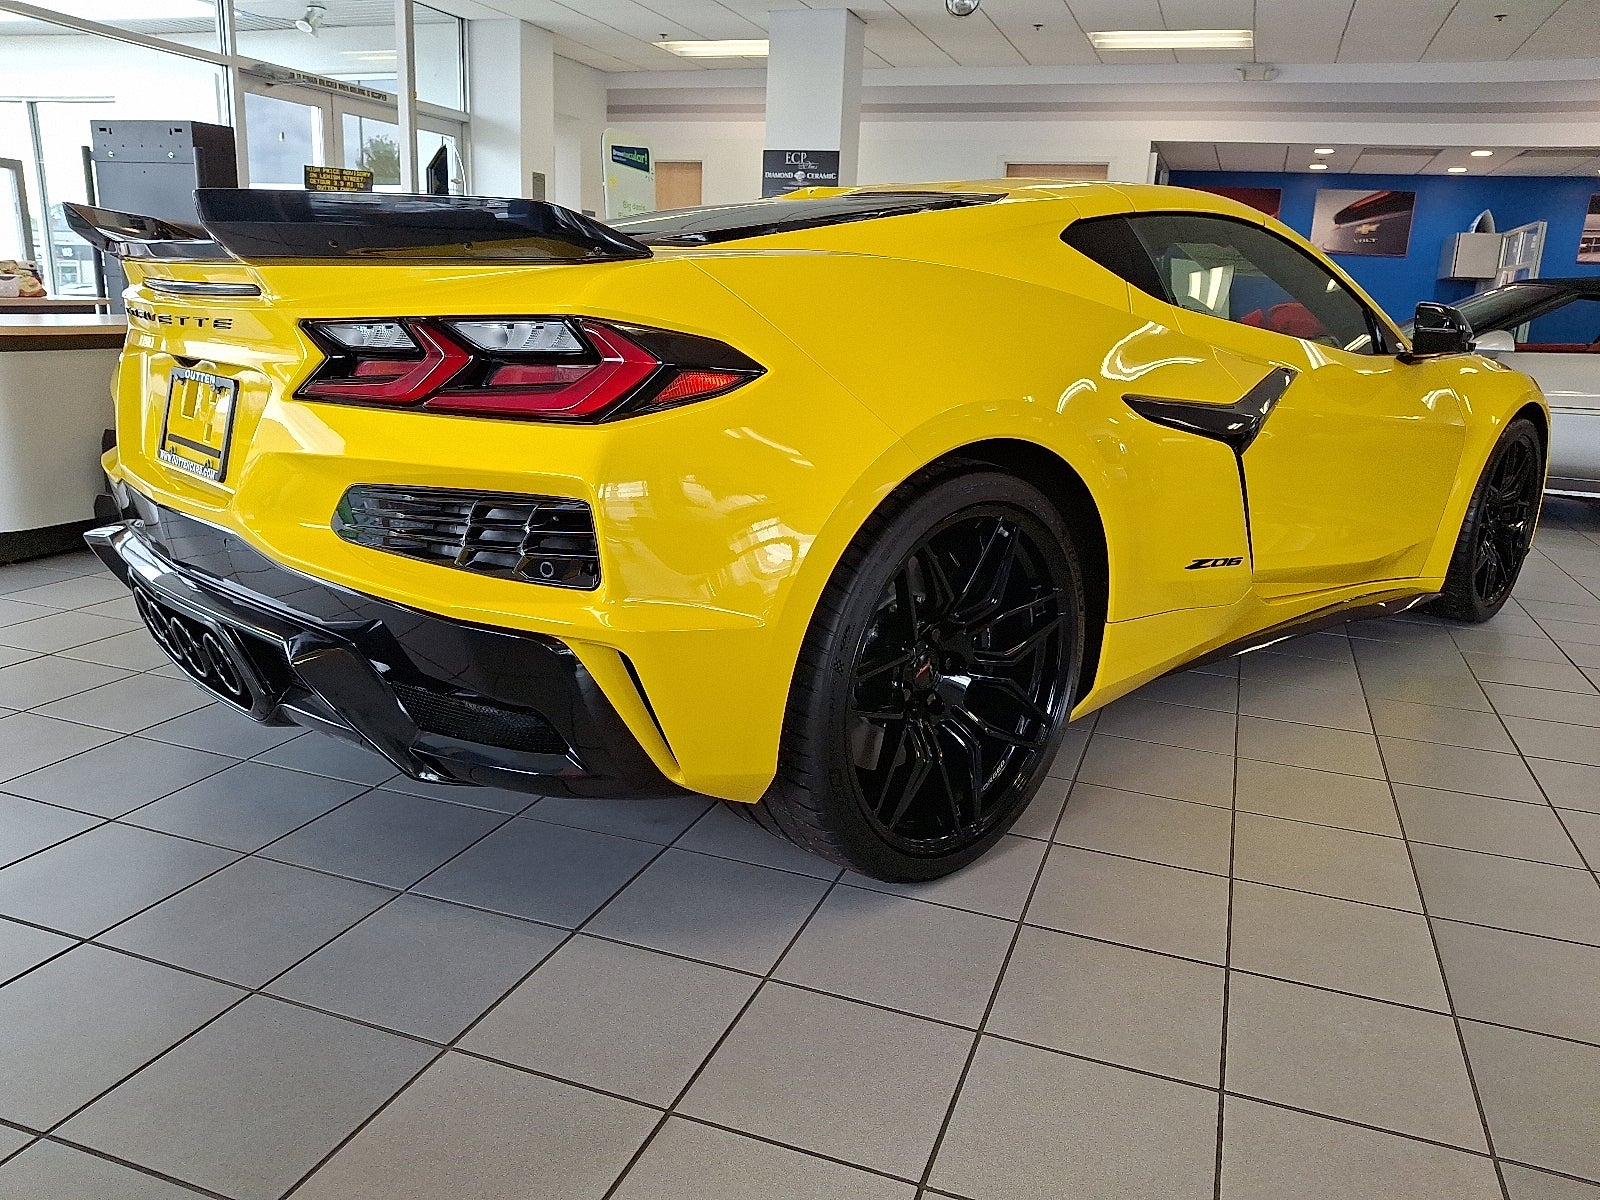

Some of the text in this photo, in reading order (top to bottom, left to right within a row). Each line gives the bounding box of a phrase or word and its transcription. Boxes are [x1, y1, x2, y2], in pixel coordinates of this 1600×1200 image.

[785, 152, 807, 164] ECP
[185, 369, 216, 385] OUTTEN
[1184, 556, 1244, 570] Z06
